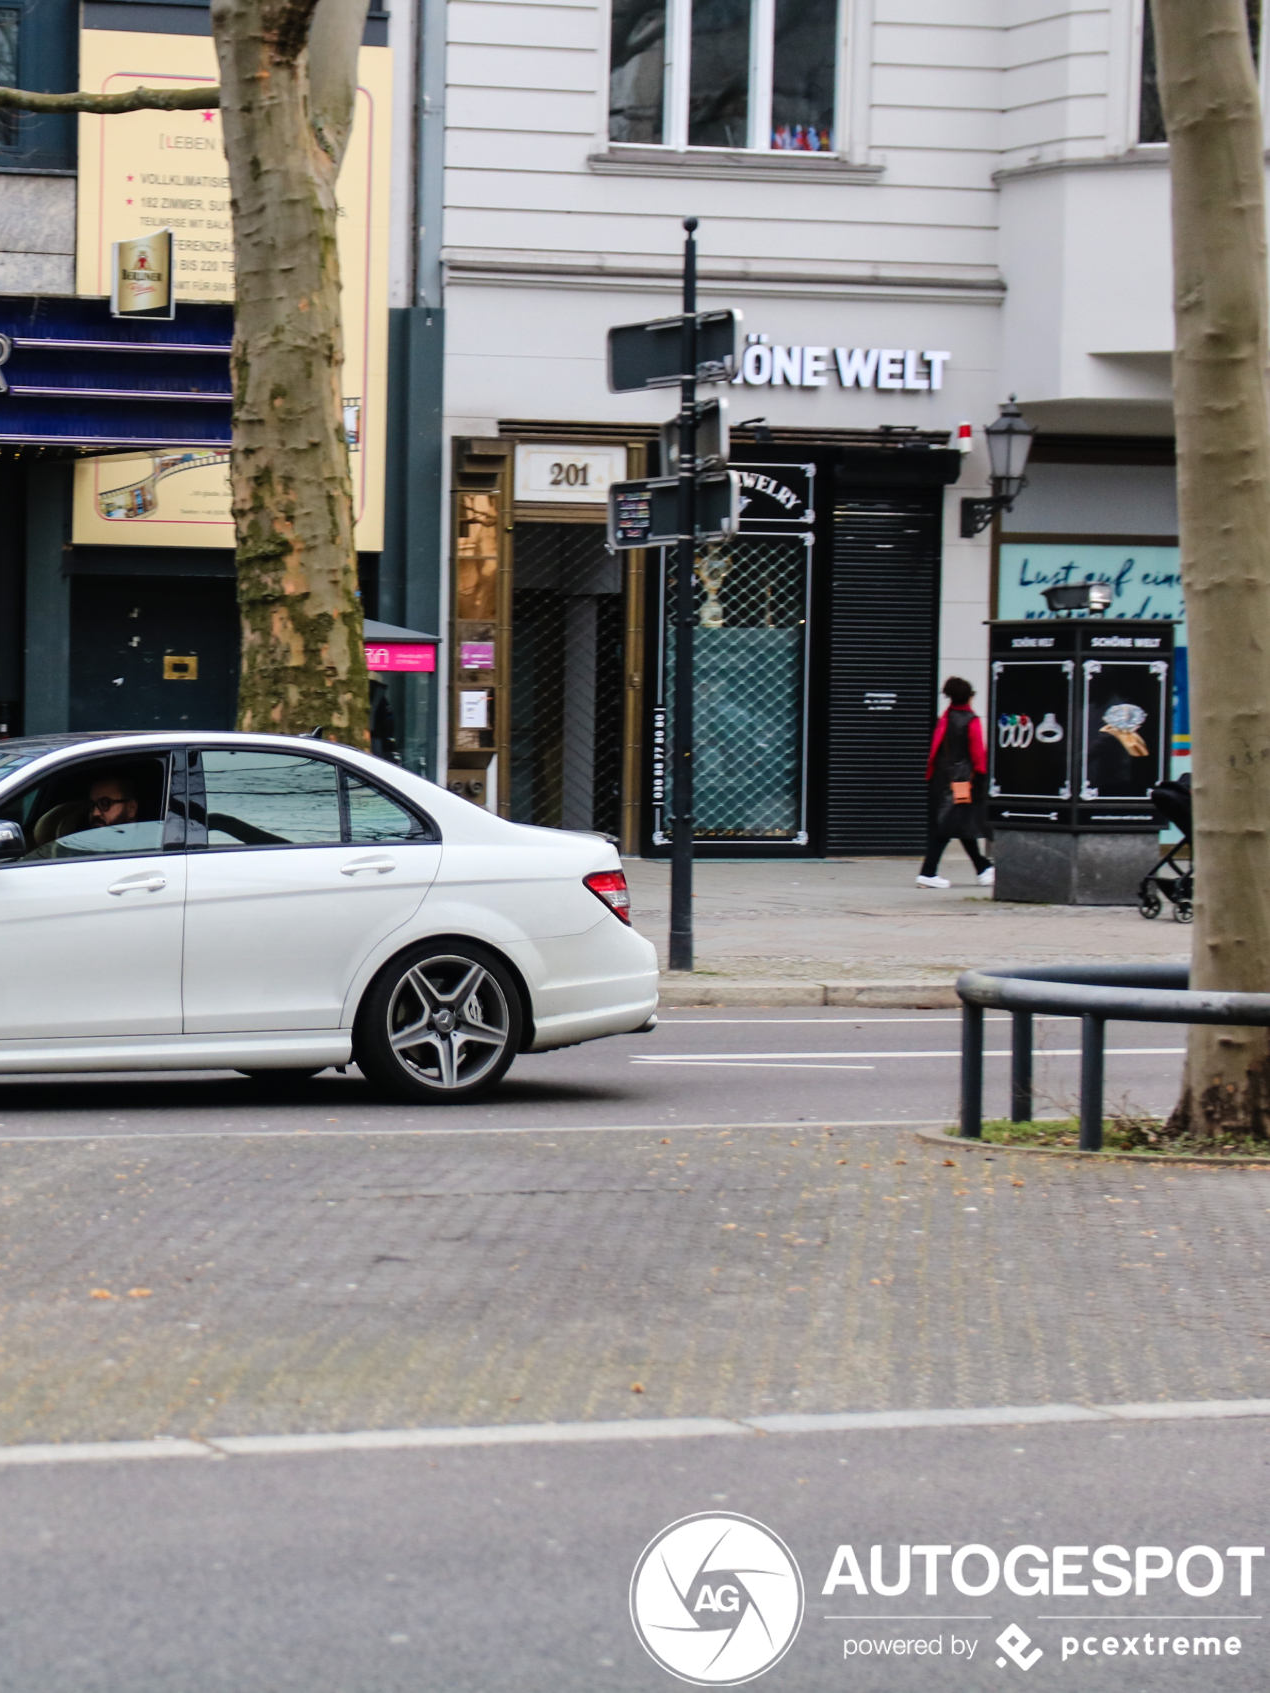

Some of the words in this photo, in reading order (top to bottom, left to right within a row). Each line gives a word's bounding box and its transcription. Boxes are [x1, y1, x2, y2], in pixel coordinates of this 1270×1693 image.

[180, 260, 198, 271] BIS
[732, 334, 828, 387] ÖNE
[836, 347, 951, 390] WELT
[550, 462, 591, 487] 201
[738, 470, 802, 510] WELRY
[1091, 635, 1133, 648] SCHÖNE
[1134, 637, 1162, 648] WELT
[653, 746, 664, 760] 77
[652, 778, 664, 799] 030
